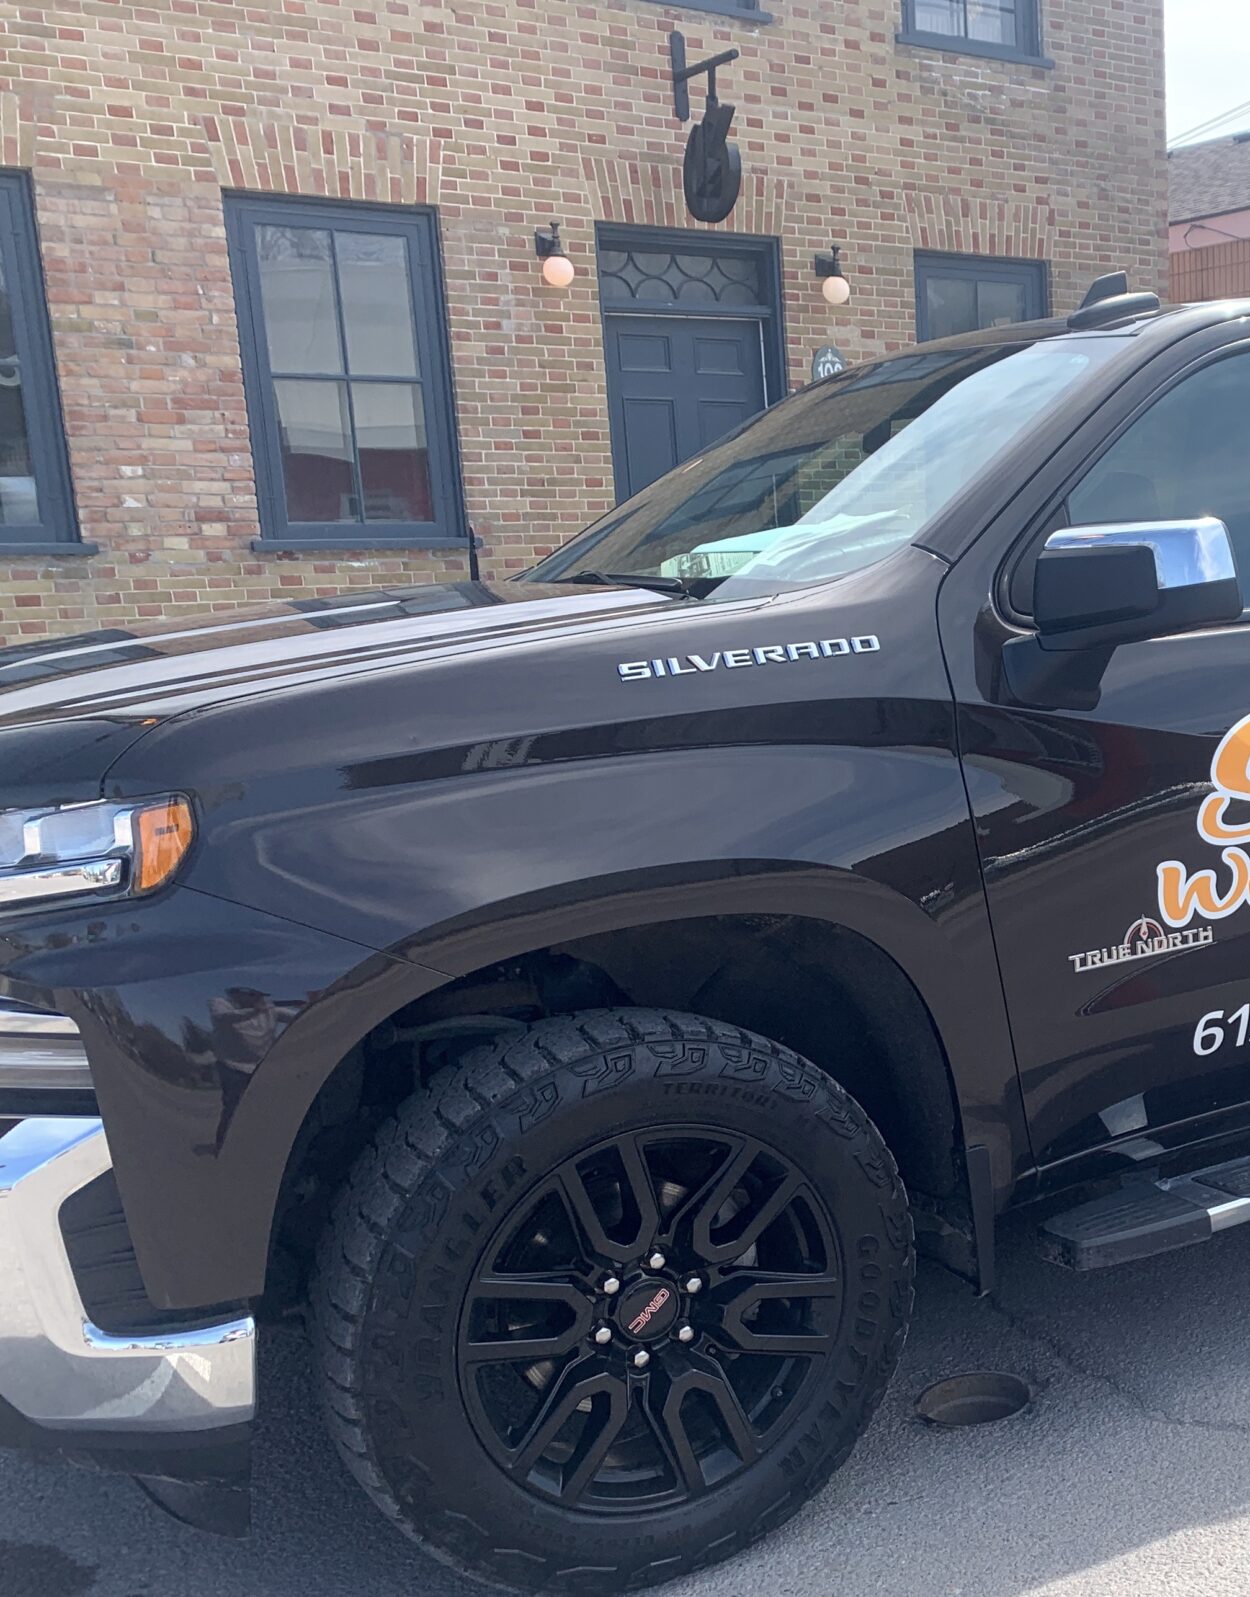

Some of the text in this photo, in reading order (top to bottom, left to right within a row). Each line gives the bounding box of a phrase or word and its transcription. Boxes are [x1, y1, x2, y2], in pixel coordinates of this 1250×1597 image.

[618, 634, 881, 682] SILVERADO
[1068, 926, 1214, 972] TRUE NORTH
[628, 1287, 670, 1335] GMC
